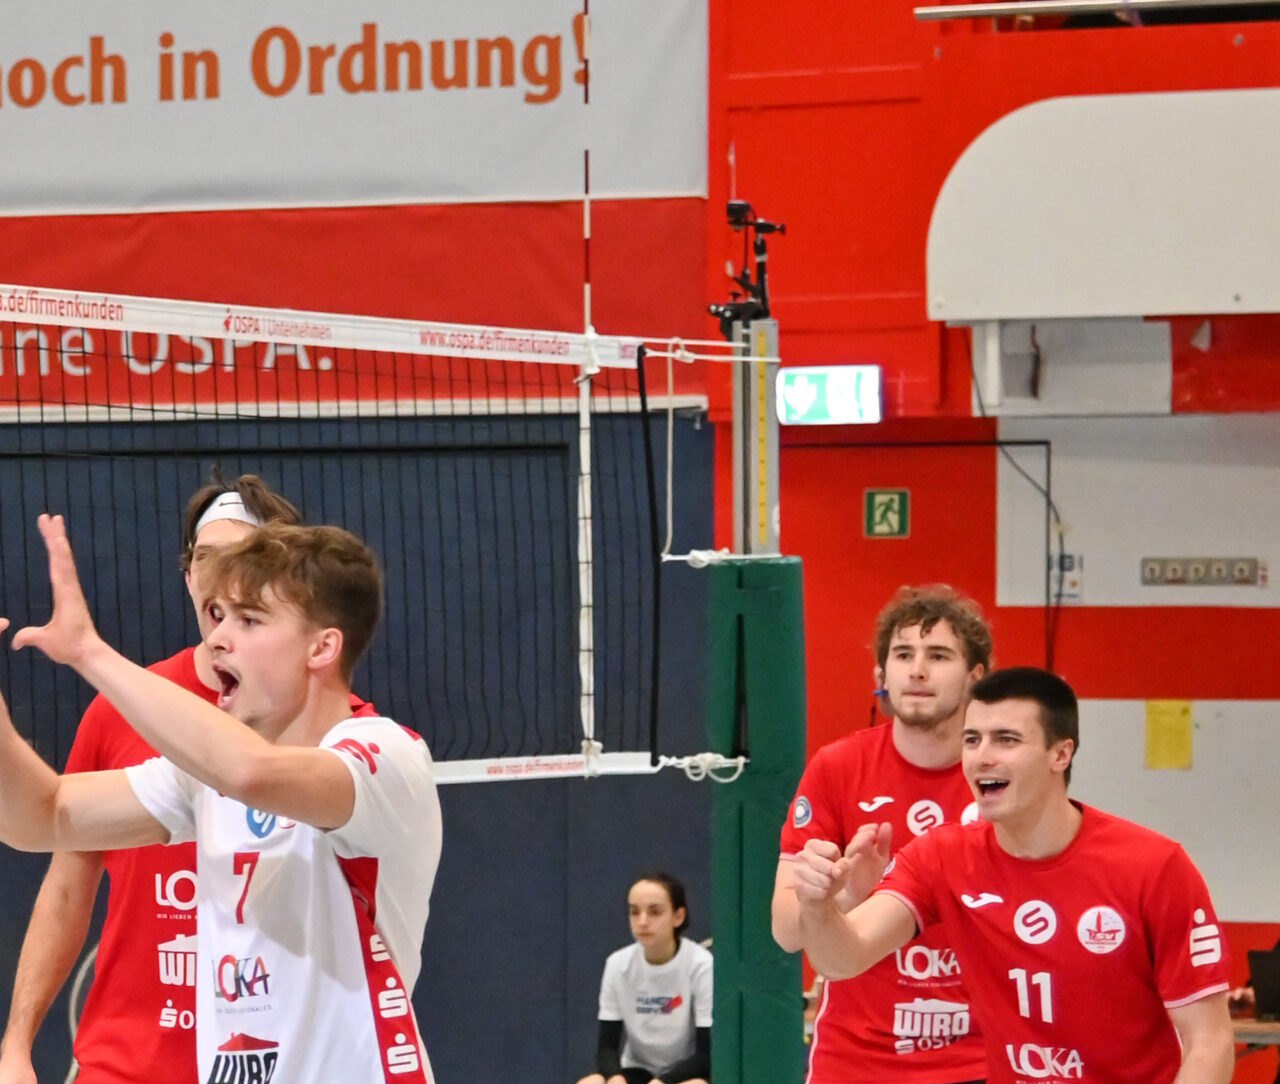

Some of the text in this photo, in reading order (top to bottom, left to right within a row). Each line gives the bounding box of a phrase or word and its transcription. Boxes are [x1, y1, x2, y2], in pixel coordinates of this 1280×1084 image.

[158, 32, 221, 102] in
[251, 12, 590, 106] Ordnung!
[233, 316, 332, 340] OSPA Unternehmen
[233, 851, 261, 925] 7
[895, 945, 962, 980] LOKA
[1008, 967, 1054, 1024] 11
[892, 1009, 970, 1038] WIRO
[1005, 1042, 1085, 1079] LOKA
